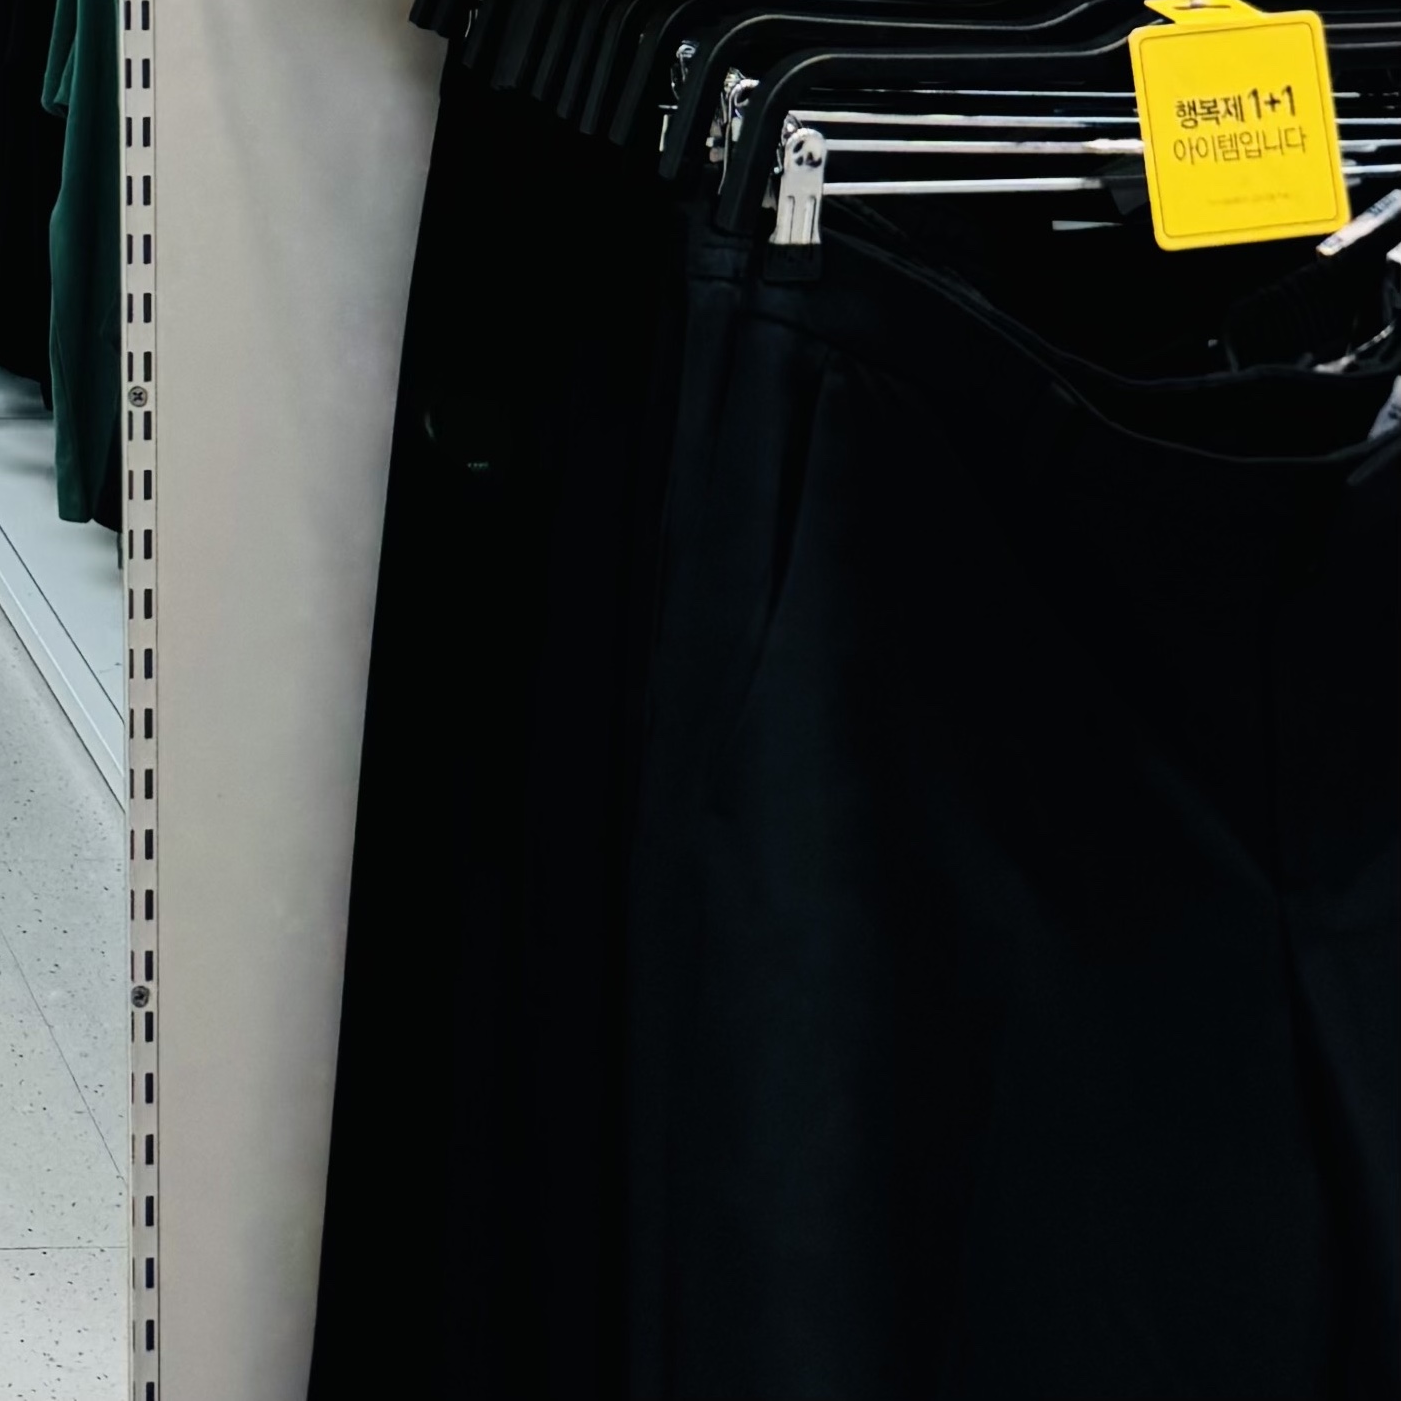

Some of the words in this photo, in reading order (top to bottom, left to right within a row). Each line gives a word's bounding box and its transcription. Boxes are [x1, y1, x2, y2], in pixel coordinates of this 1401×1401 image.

[1175, 94, 1245, 130] 행복제
[1247, 84, 1296, 120] 1+1
[1173, 126, 1308, 165] 아이템입니다
